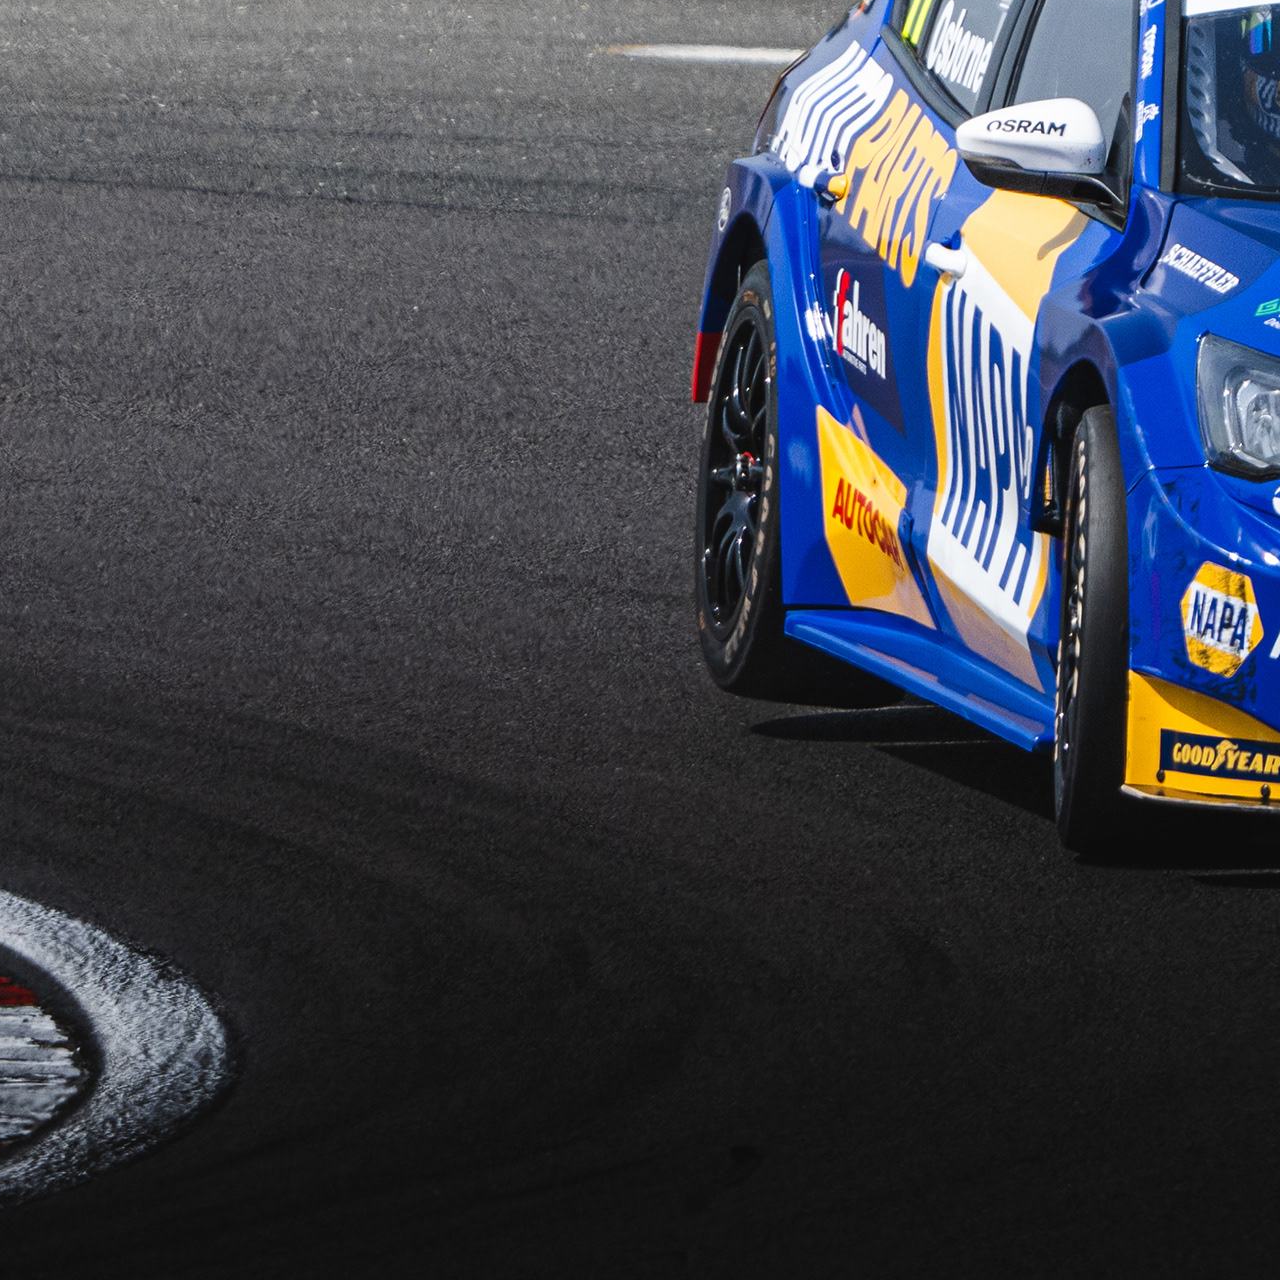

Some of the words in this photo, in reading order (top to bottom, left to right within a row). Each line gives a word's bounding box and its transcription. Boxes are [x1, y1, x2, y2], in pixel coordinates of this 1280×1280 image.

[927, 0, 993, 94] Osborne
[770, 40, 894, 174] AUTO
[834, 88, 958, 288] PARTS
[986, 118, 1067, 138] OSRAM
[1162, 243, 1240, 294] SCHAEFFLER
[833, 267, 886, 379] fahren
[940, 280, 1036, 607] NAPA
[1188, 588, 1247, 651] NAPA
